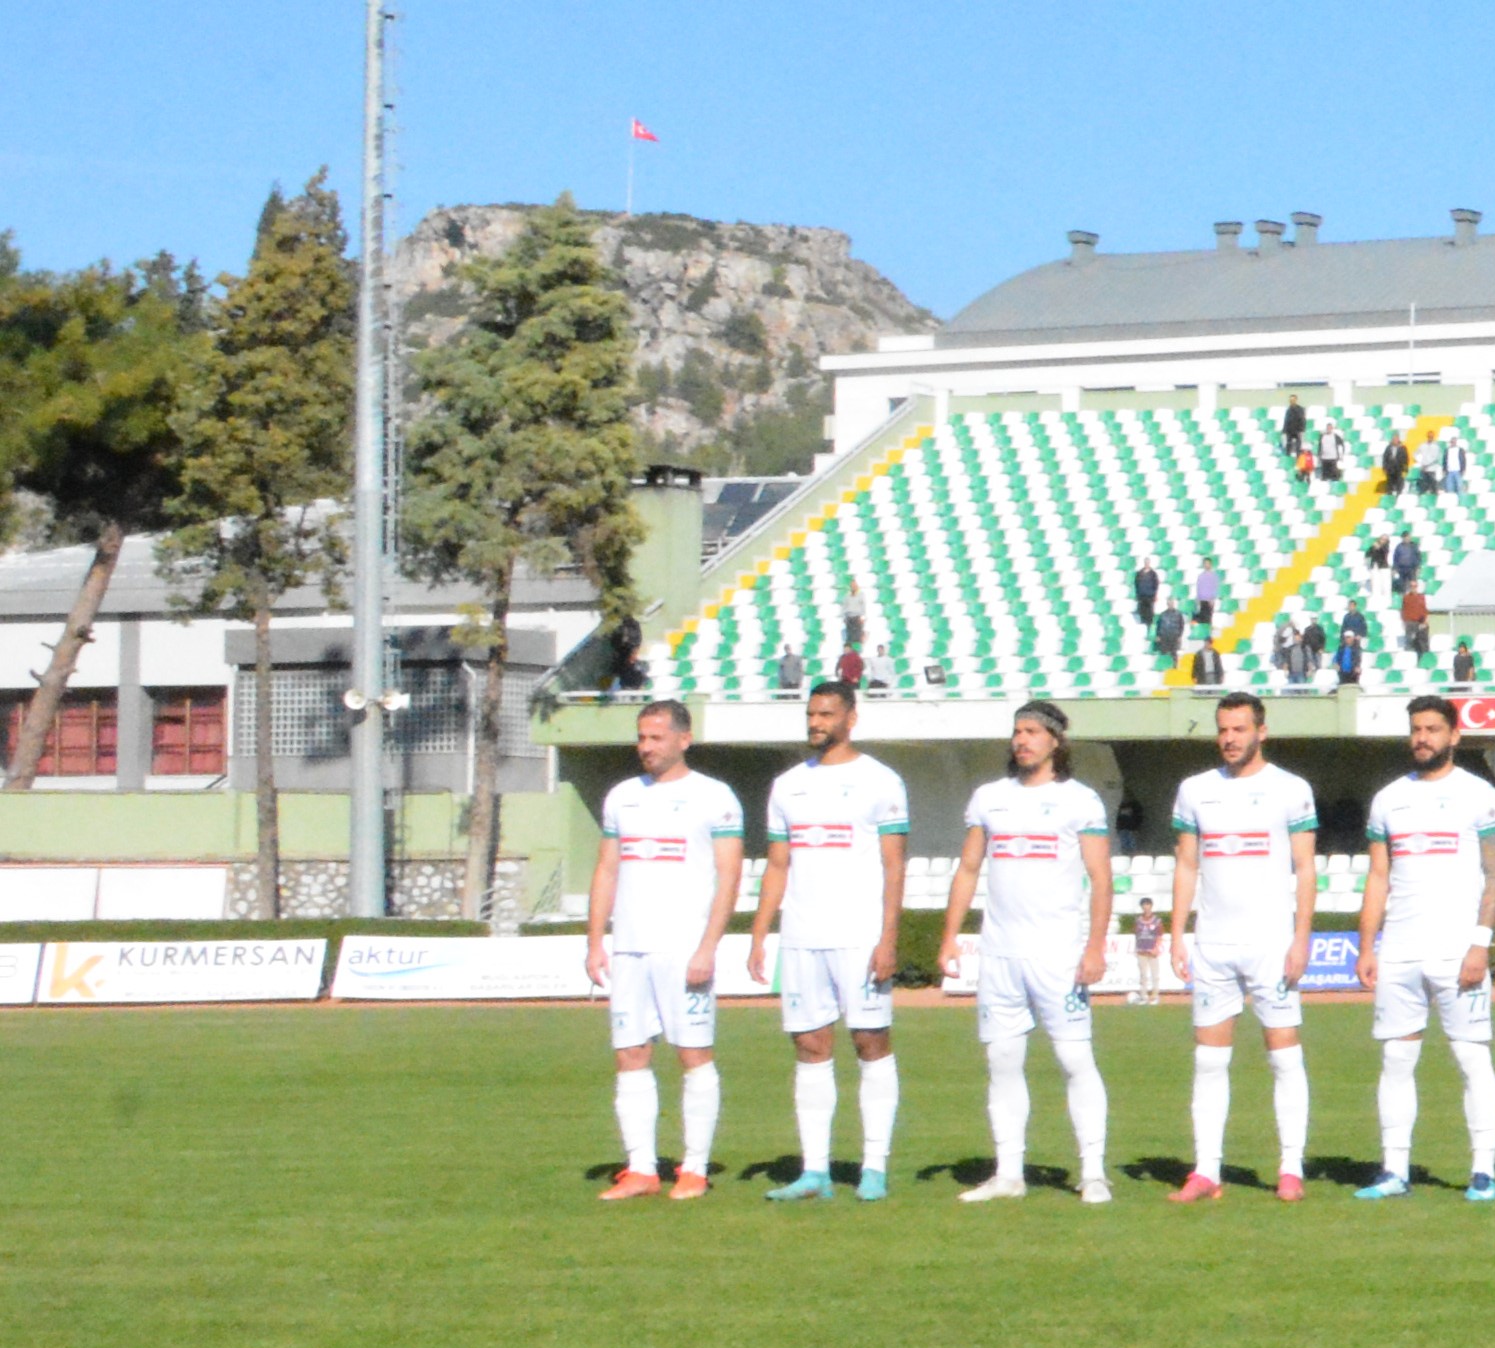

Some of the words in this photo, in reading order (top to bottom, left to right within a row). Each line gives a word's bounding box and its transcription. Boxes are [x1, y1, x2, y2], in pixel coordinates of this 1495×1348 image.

[117, 945, 316, 967] KURMERSAN
[347, 945, 429, 965] aktur
[687, 994, 712, 1016] 22
[1466, 990, 1489, 1013] 77
